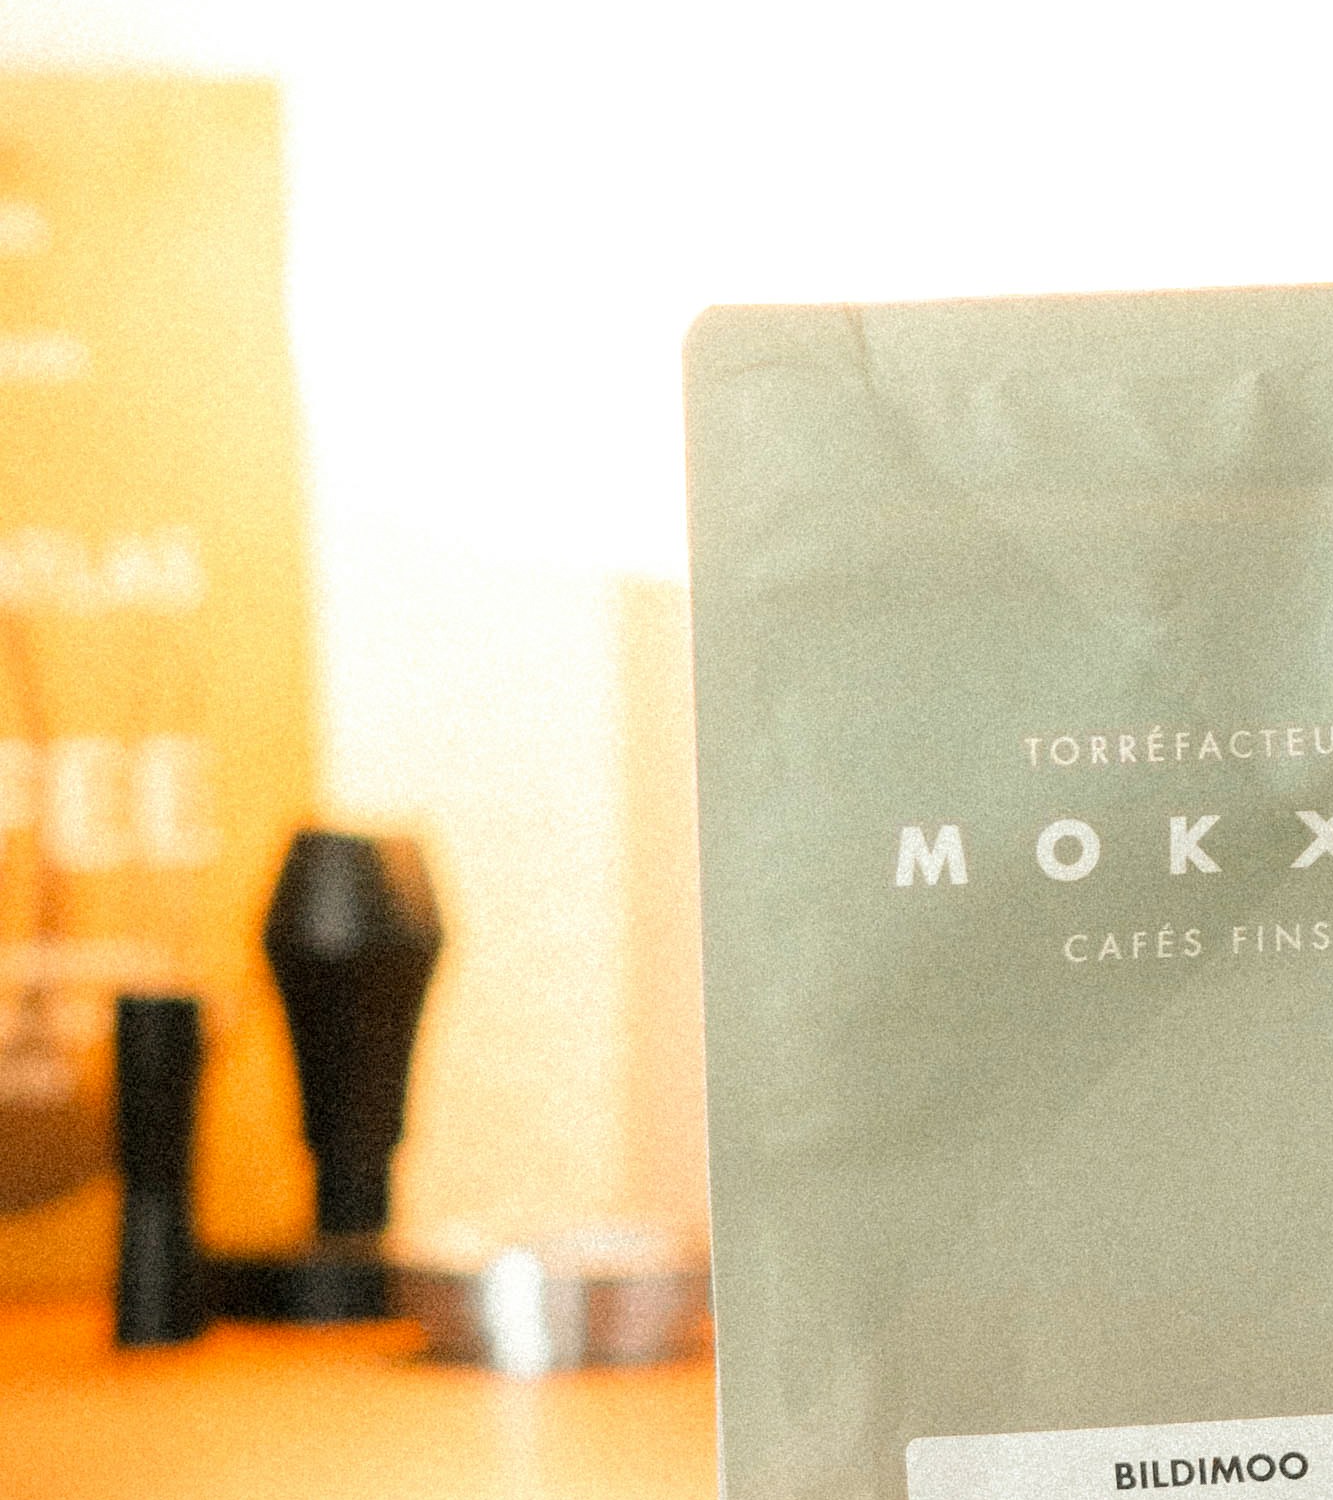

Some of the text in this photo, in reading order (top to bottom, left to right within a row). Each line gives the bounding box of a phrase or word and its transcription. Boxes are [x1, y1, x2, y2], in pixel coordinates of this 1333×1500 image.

[1064, 921, 1331, 963] CAFÉS FINS
[1115, 1452, 1309, 1490] BILDIMOO
